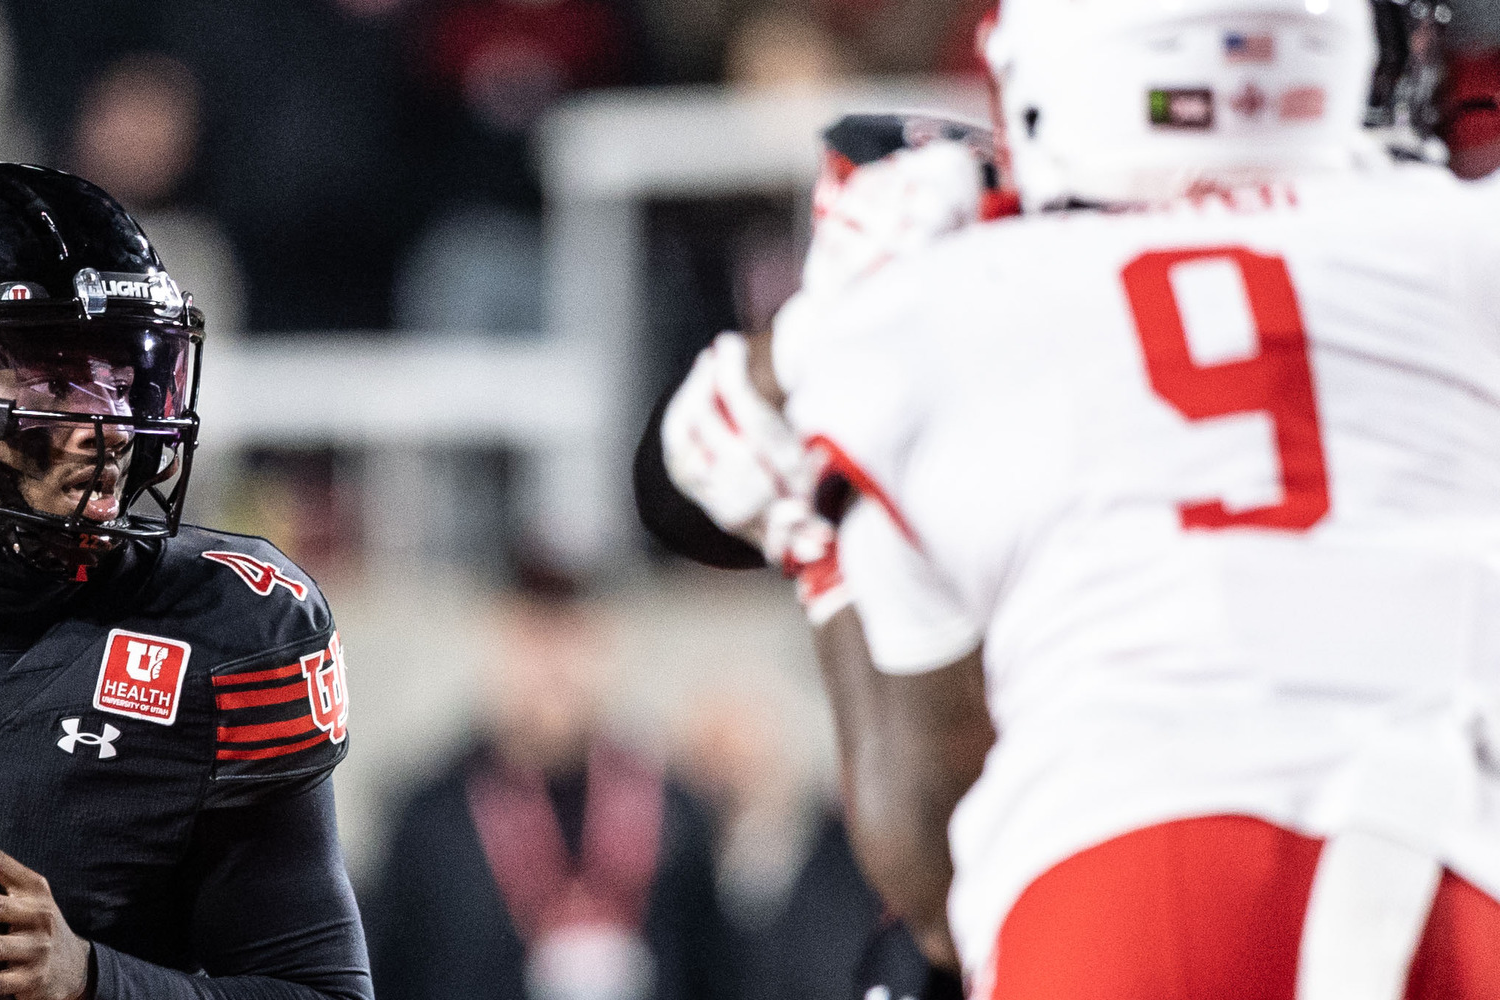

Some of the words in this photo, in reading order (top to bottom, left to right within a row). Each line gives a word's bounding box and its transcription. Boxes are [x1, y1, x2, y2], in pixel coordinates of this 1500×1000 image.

[1119, 244, 1332, 534] 9
[202, 550, 308, 602] 4
[101, 695, 140, 711] UNIVERSITY
[140, 703, 151, 712] OF
[150, 705, 169, 717] UTAH
[103, 679, 172, 708] HEALTH
